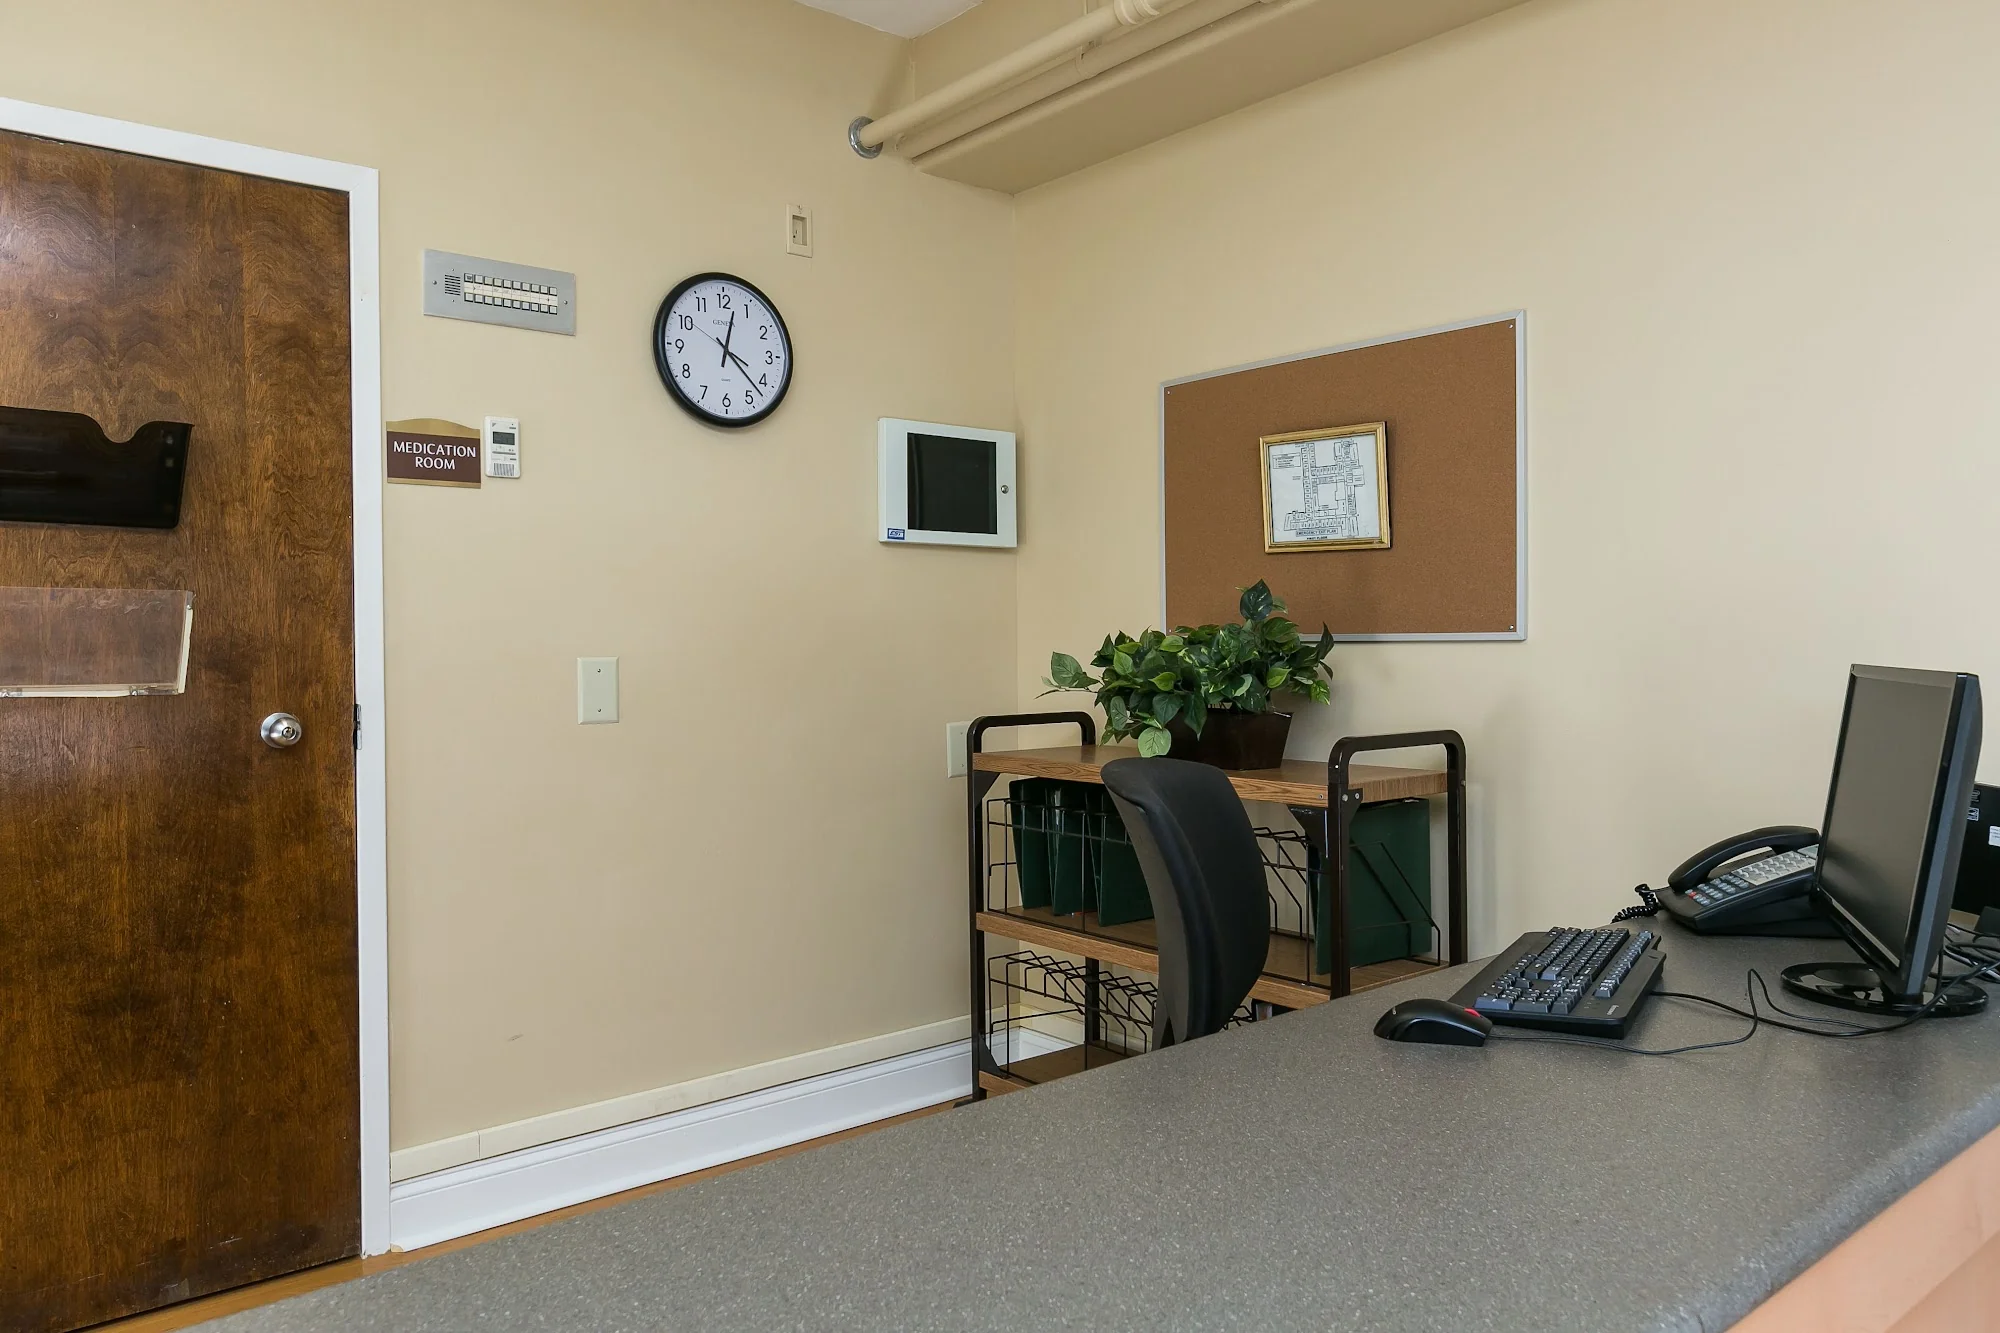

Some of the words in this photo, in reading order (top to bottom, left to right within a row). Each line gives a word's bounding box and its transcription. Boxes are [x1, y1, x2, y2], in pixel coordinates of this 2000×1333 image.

[695, 297, 707, 312] 11
[716, 293, 731, 309] 12
[743, 303, 749, 318] 1
[678, 315, 694, 330] 10
[712, 319, 736, 327] GENEA
[760, 326, 767, 340] 2
[675, 339, 684, 353] 9
[765, 351, 773, 365] 3
[682, 364, 690, 378] 8
[759, 373, 767, 387] 4
[699, 384, 708, 400] 7
[745, 390, 753, 404] 5
[722, 393, 731, 407] 6
[394, 441, 476, 457] MEDICATION
[416, 457, 455, 469] ROOM
